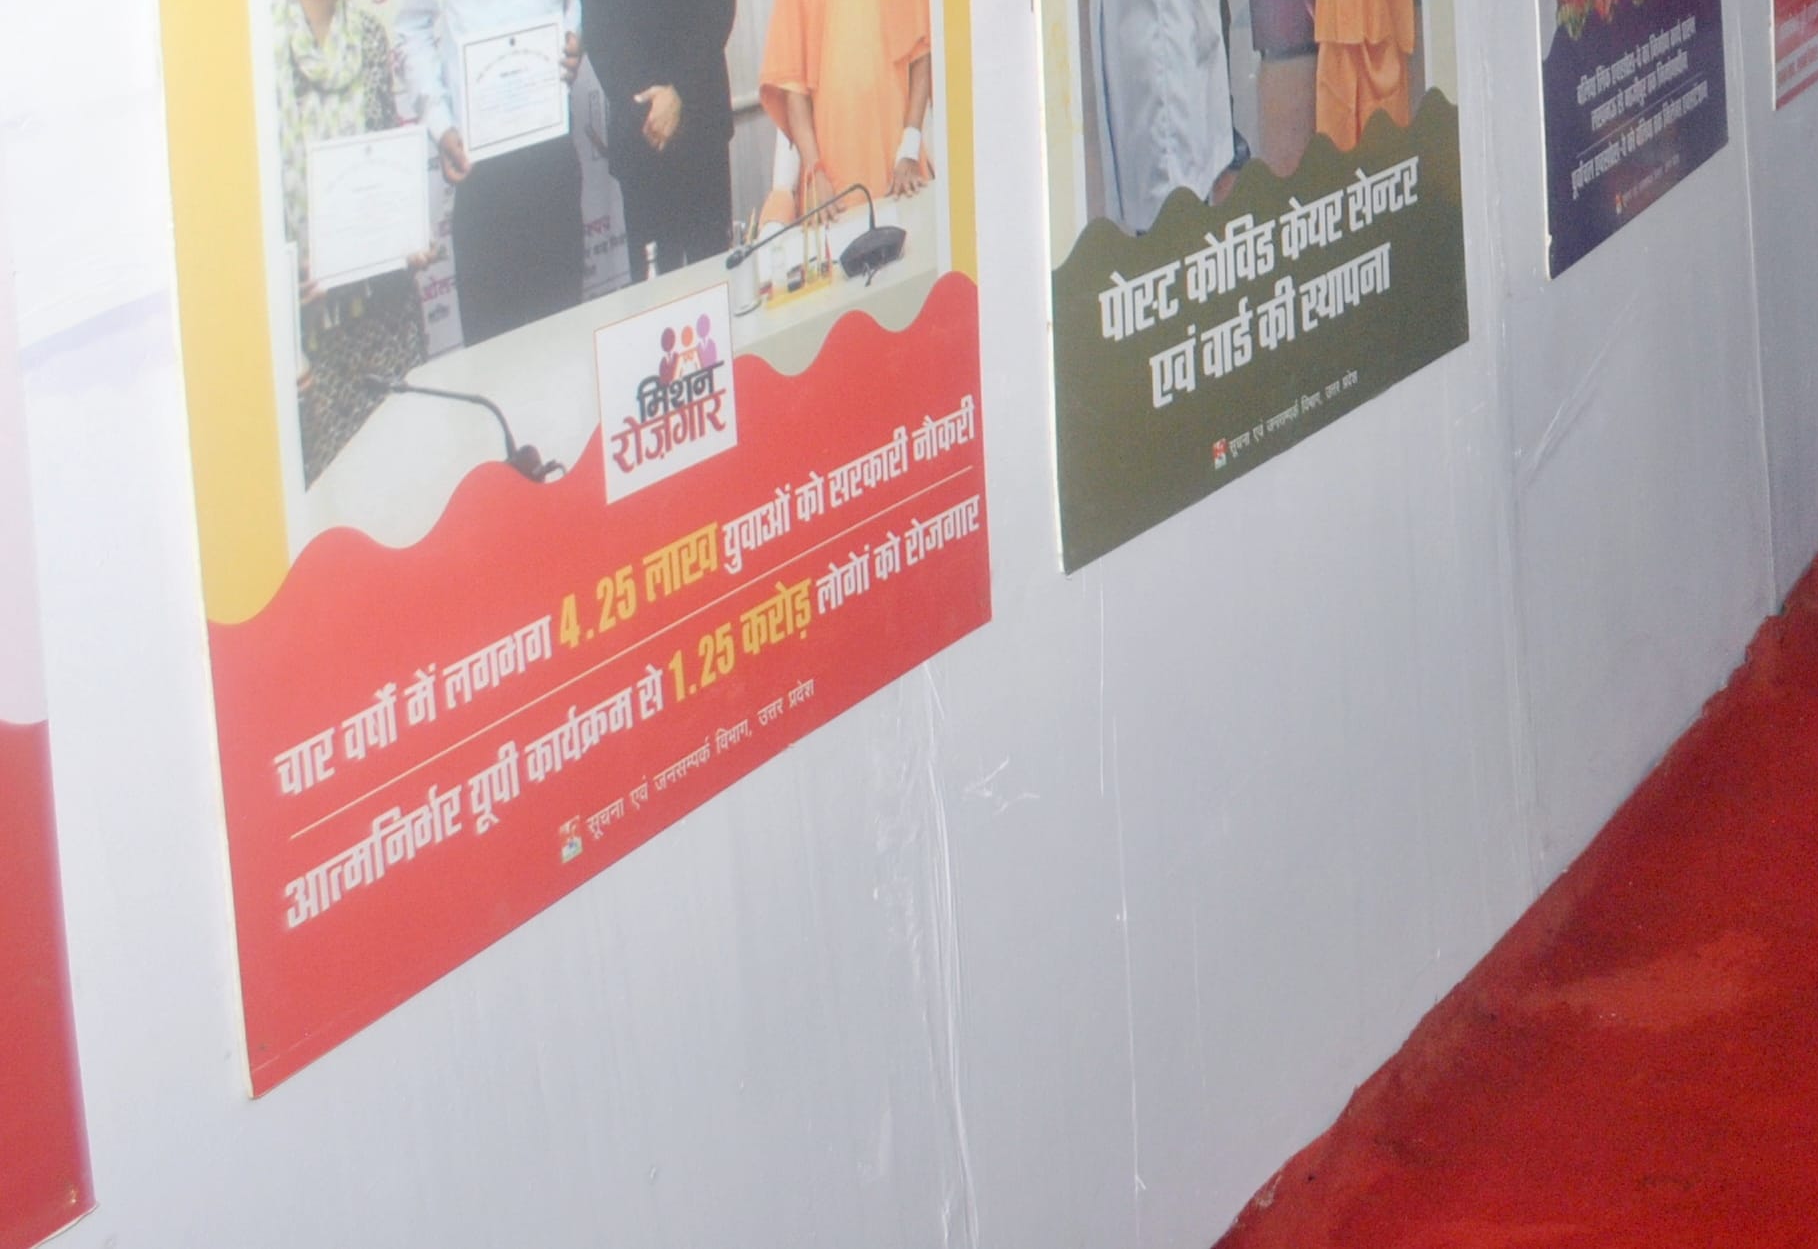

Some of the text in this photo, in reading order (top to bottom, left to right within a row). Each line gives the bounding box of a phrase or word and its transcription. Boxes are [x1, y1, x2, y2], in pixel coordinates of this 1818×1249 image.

[1098, 155, 1419, 342] पोस्ट कोविड केयर सेन्टर
[1149, 242, 1391, 411] एवं वार्ड की स्थापना
[636, 360, 725, 424] मिशन
[273, 394, 976, 796] चार वर्षों में लगभग 4.25 लाख युवाओं को सरकारी नौकरी
[284, 494, 980, 930] आत्मनिर्भर यूपी कार्यक्रम से 1.25 करोड़ लोगों को रोजगार
[586, 797, 625, 839] सूचना
[630, 774, 648, 810] एवं
[653, 736, 711, 792] जनसम्पर्क
[757, 698, 785, 727] उत्तर
[788, 678, 815, 709] प्रदेश
